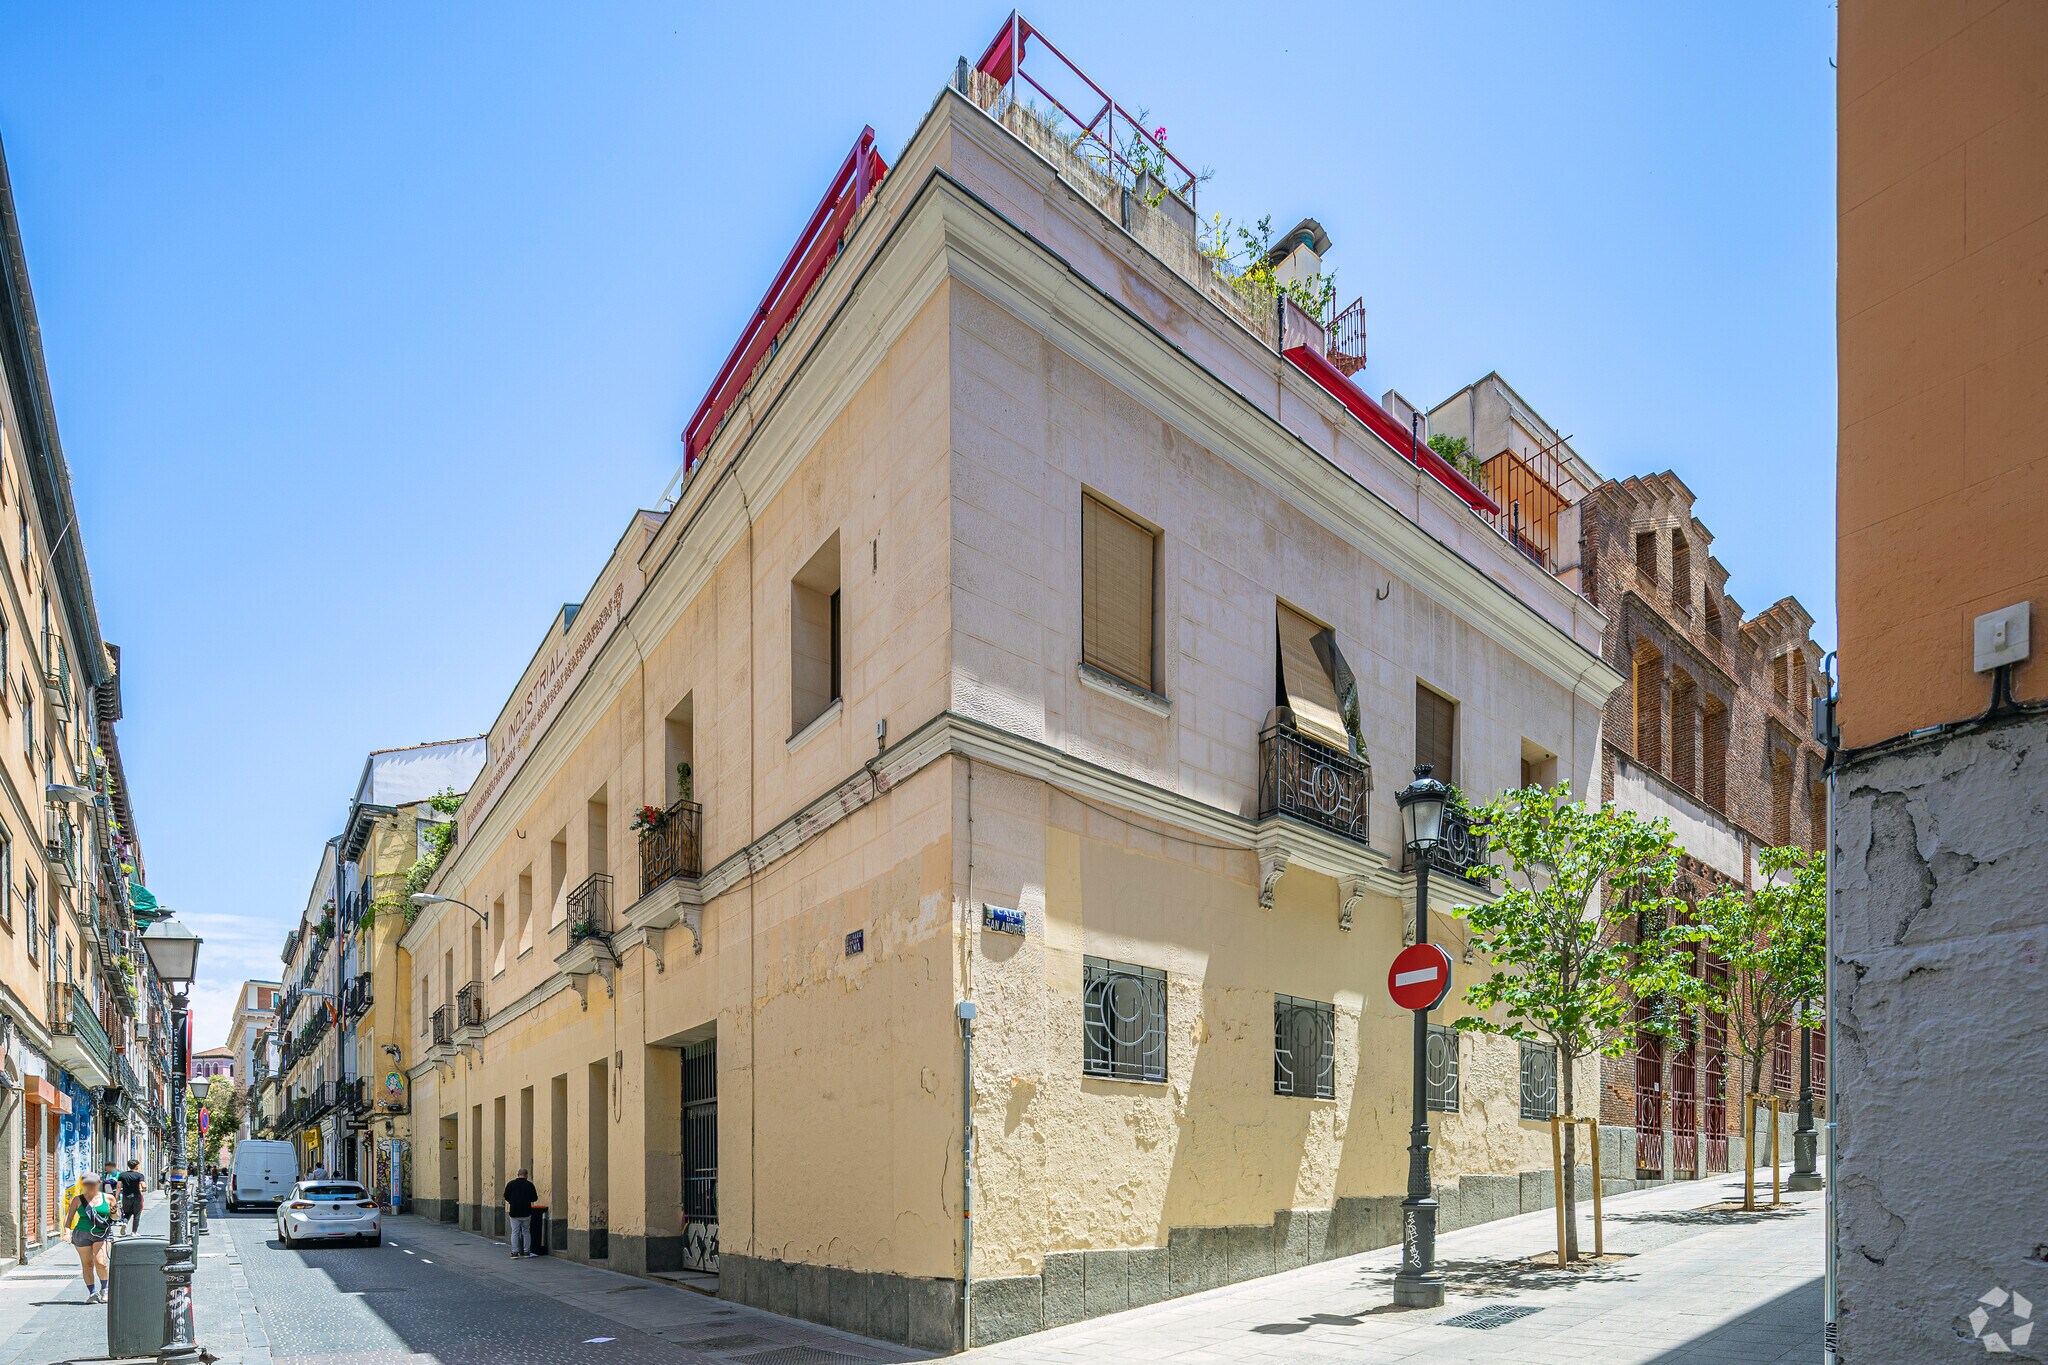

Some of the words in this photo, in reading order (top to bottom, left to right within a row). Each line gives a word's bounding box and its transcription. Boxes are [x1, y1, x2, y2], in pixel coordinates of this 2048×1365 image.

[494, 736, 506, 766] LA
[508, 648, 565, 746] INDUSTRIAL
[997, 907, 1024, 920] CALLE
[985, 918, 1000, 931] SAN
